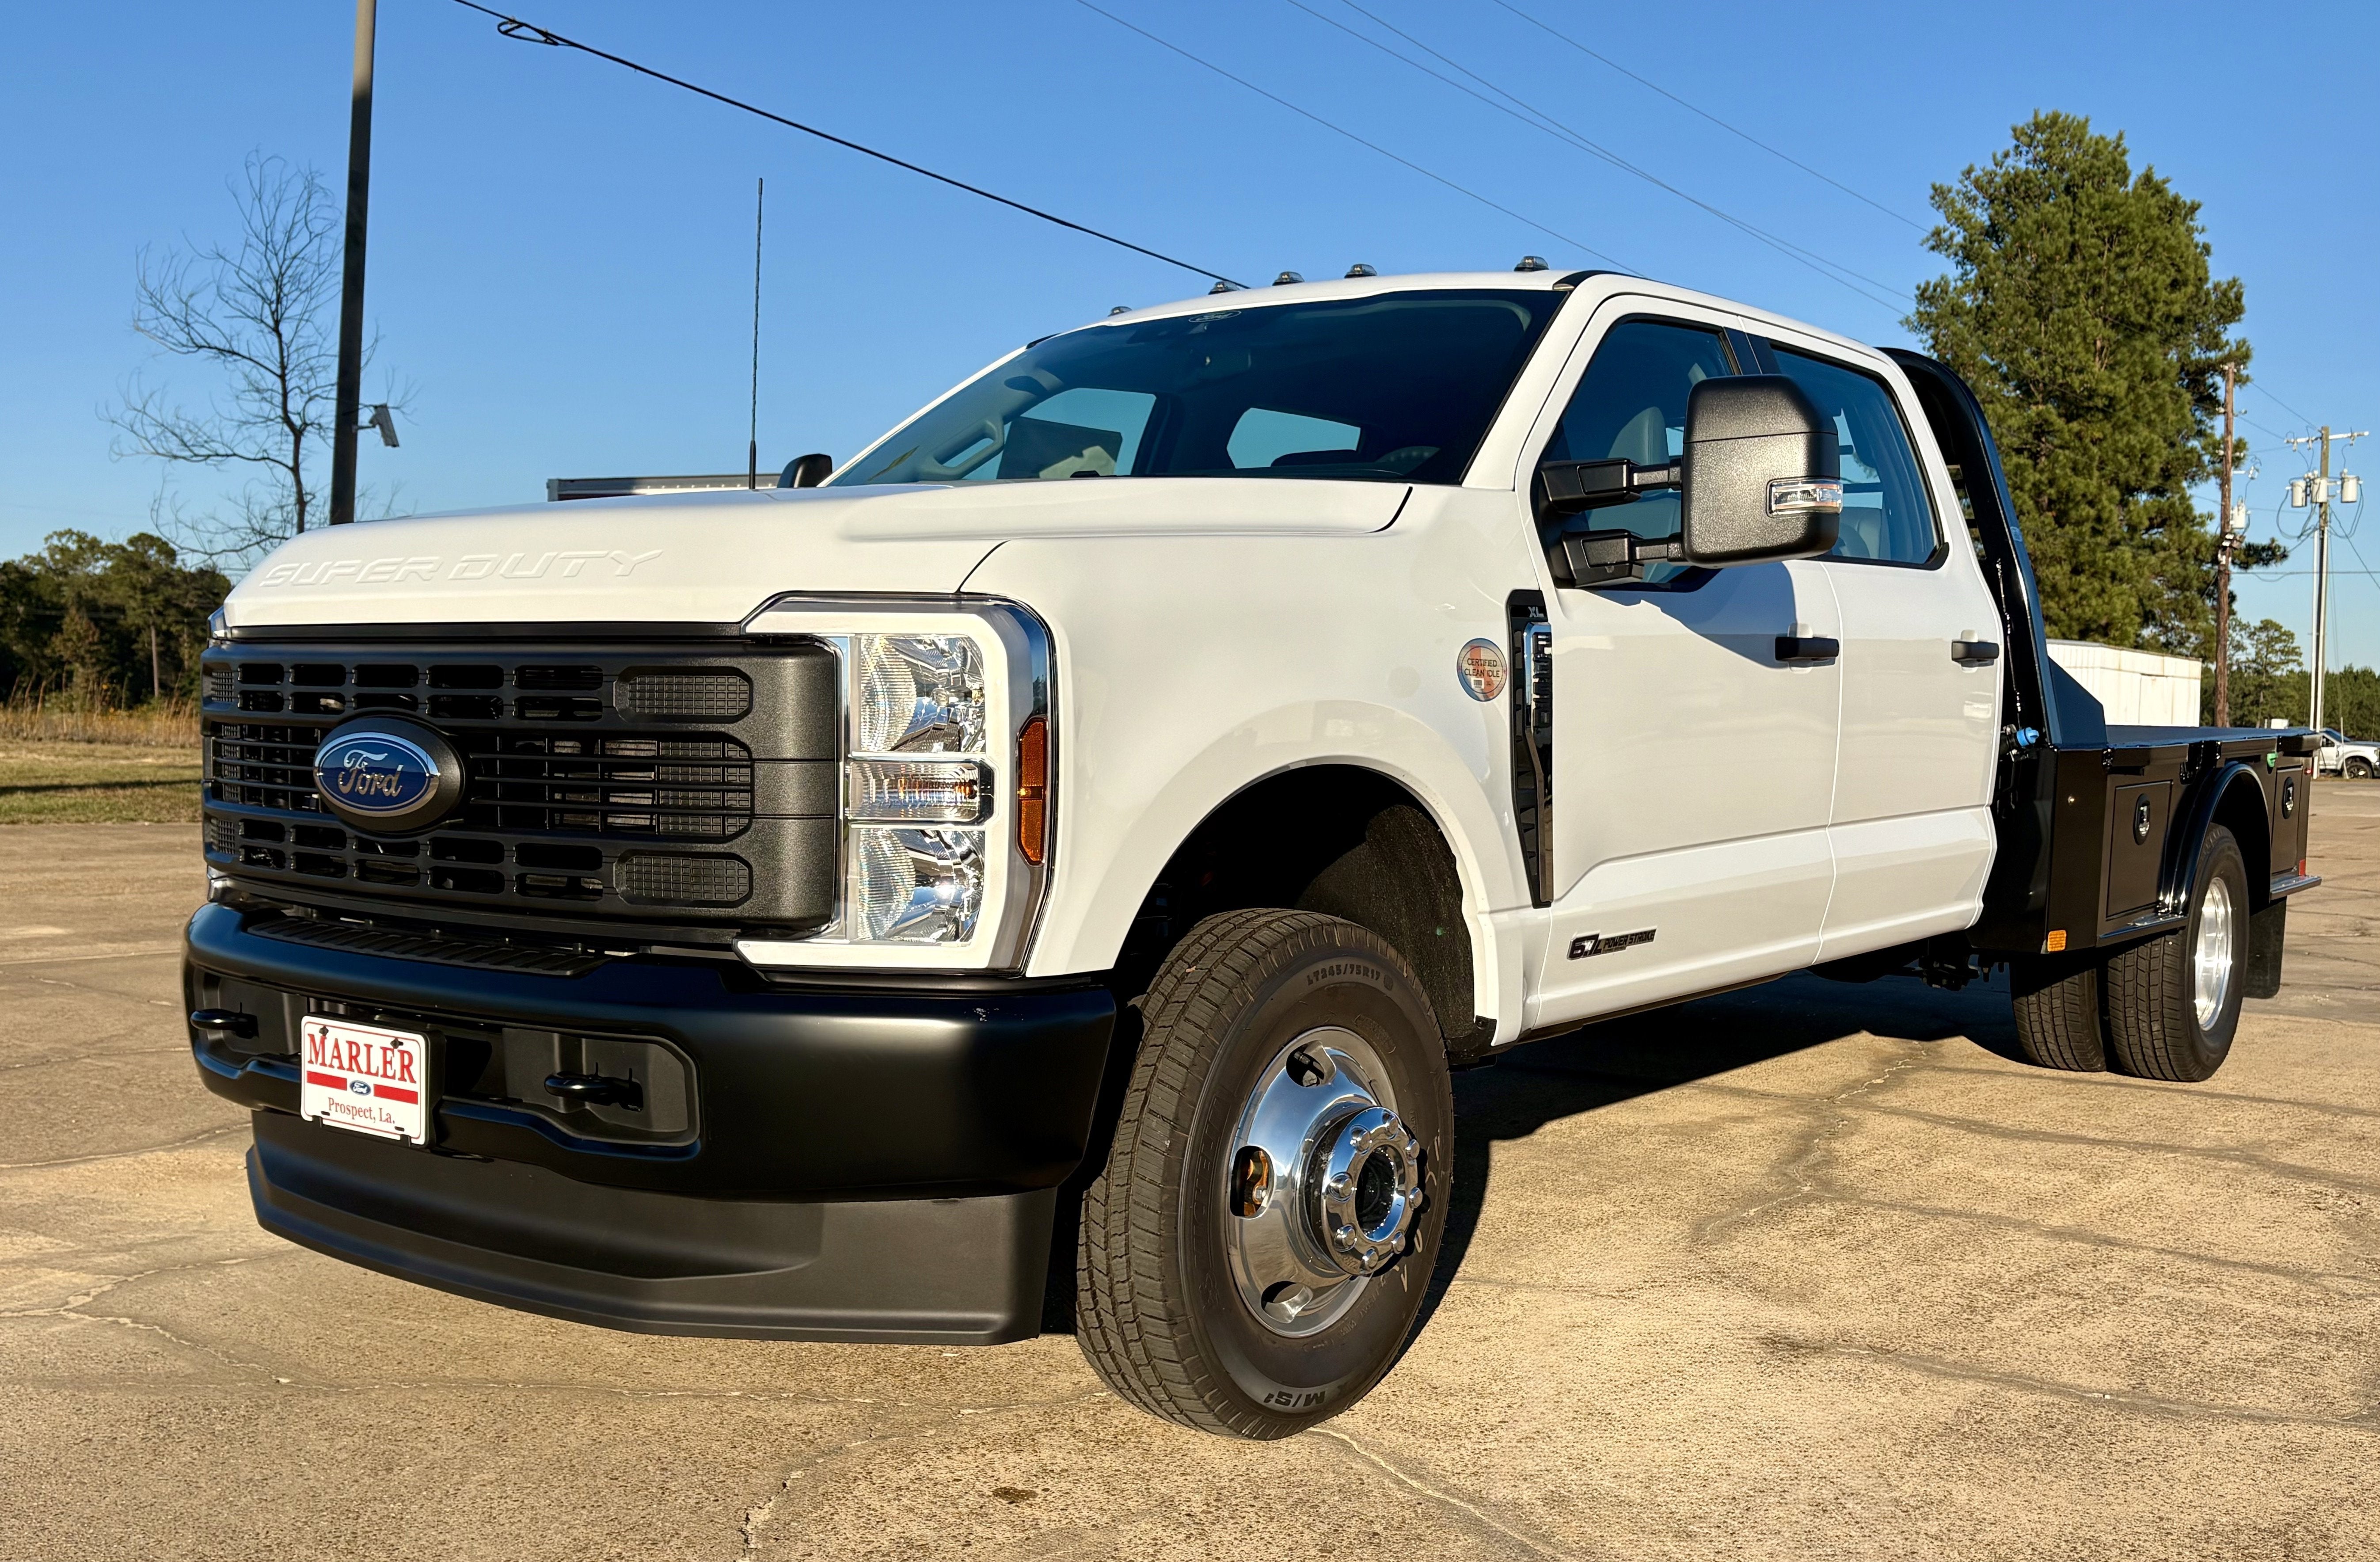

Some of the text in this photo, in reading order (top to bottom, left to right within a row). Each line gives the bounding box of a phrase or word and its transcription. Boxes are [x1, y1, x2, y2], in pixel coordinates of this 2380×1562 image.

[259, 549, 664, 587] SUPER DUTY
[1528, 606, 1544, 617] XL
[1464, 668, 1485, 677] CLEAN
[1467, 658, 1497, 667] CERTIFIED
[338, 749, 404, 797] Ford
[1604, 934, 1628, 949] POWER
[1628, 929, 1656, 945] STROKE
[1307, 963, 1381, 986] LT245/75R17
[308, 1033, 417, 1084] MARLER
[353, 1082, 368, 1094] Ford
[327, 1097, 395, 1124] Prospect, La.
